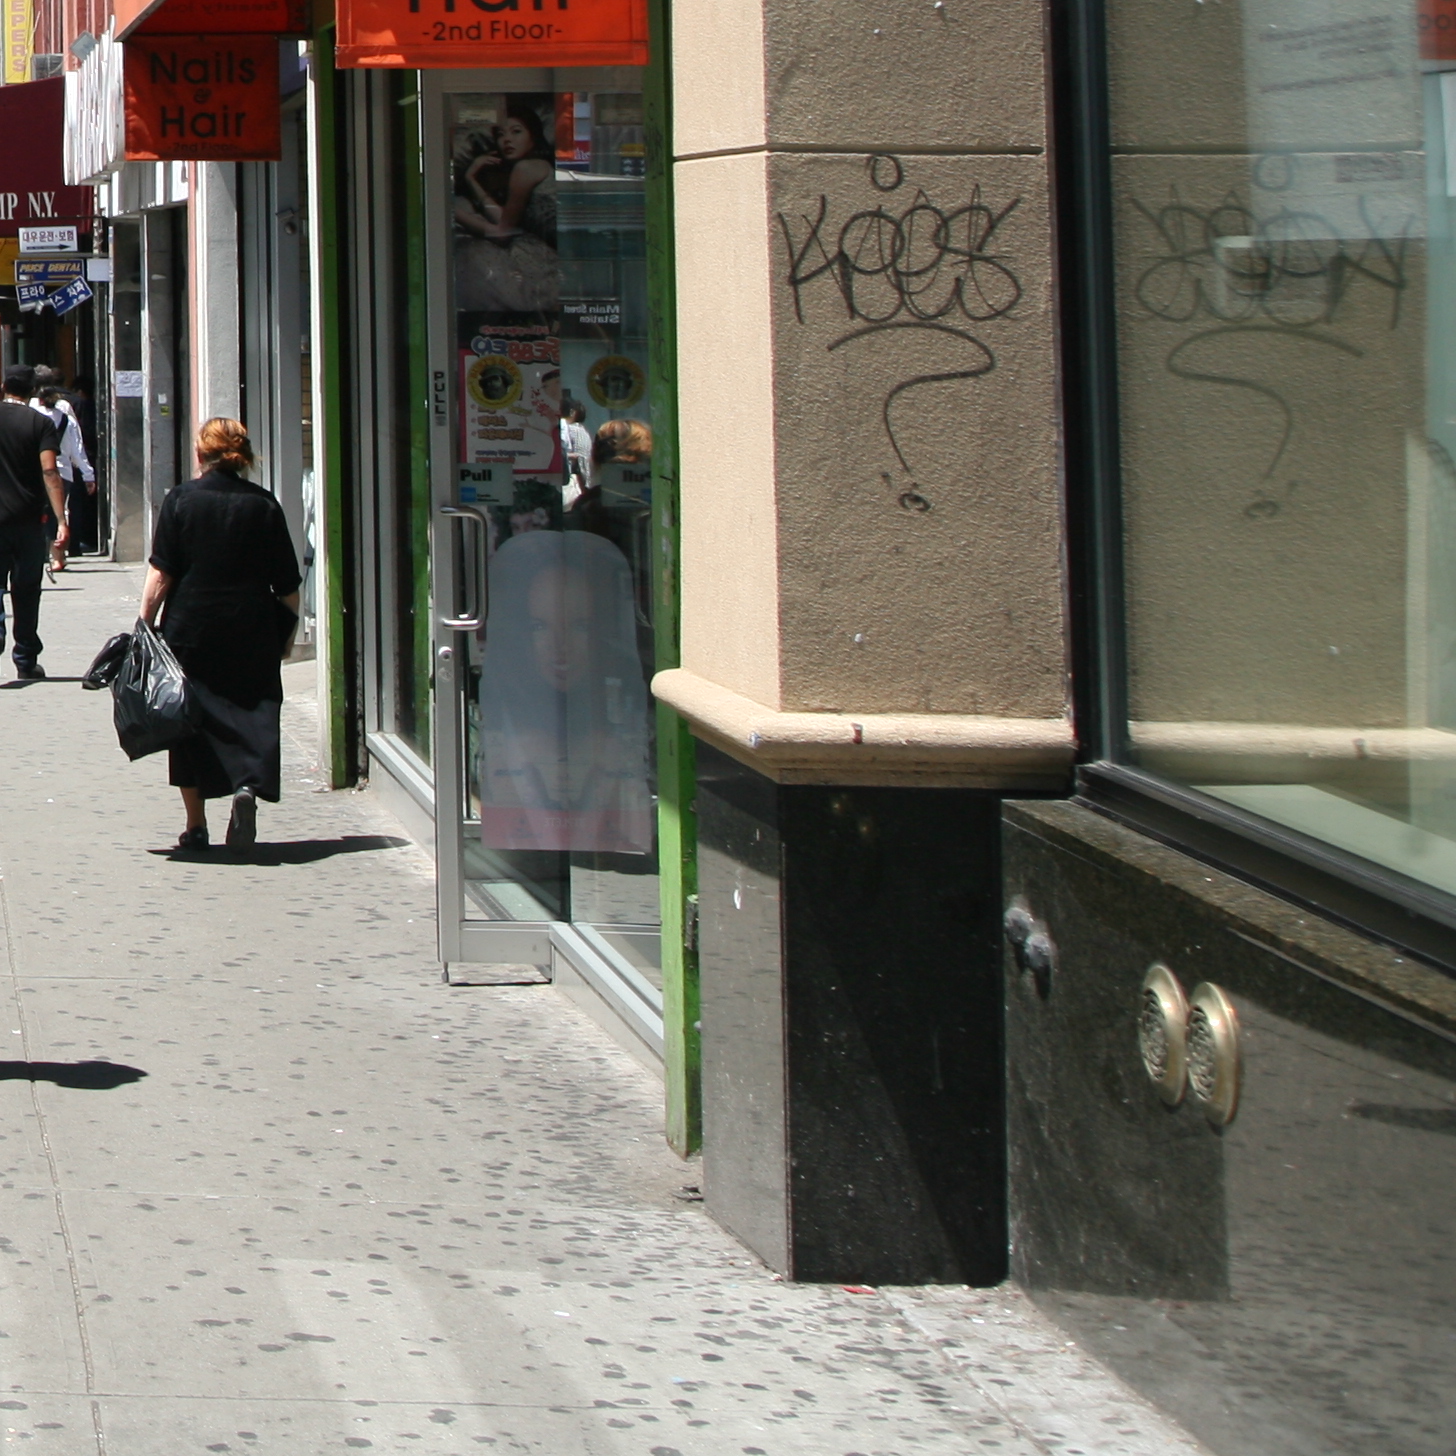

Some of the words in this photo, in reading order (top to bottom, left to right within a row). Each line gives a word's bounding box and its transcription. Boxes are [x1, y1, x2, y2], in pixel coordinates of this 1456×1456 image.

[150, 52, 256, 84] Nails
[160, 104, 247, 138] Hair
[27, 192, 58, 218] N.Y.
[47, 263, 82, 272] DENTAL
[433, 371, 446, 415] PULL
[460, 469, 492, 481] Pull
